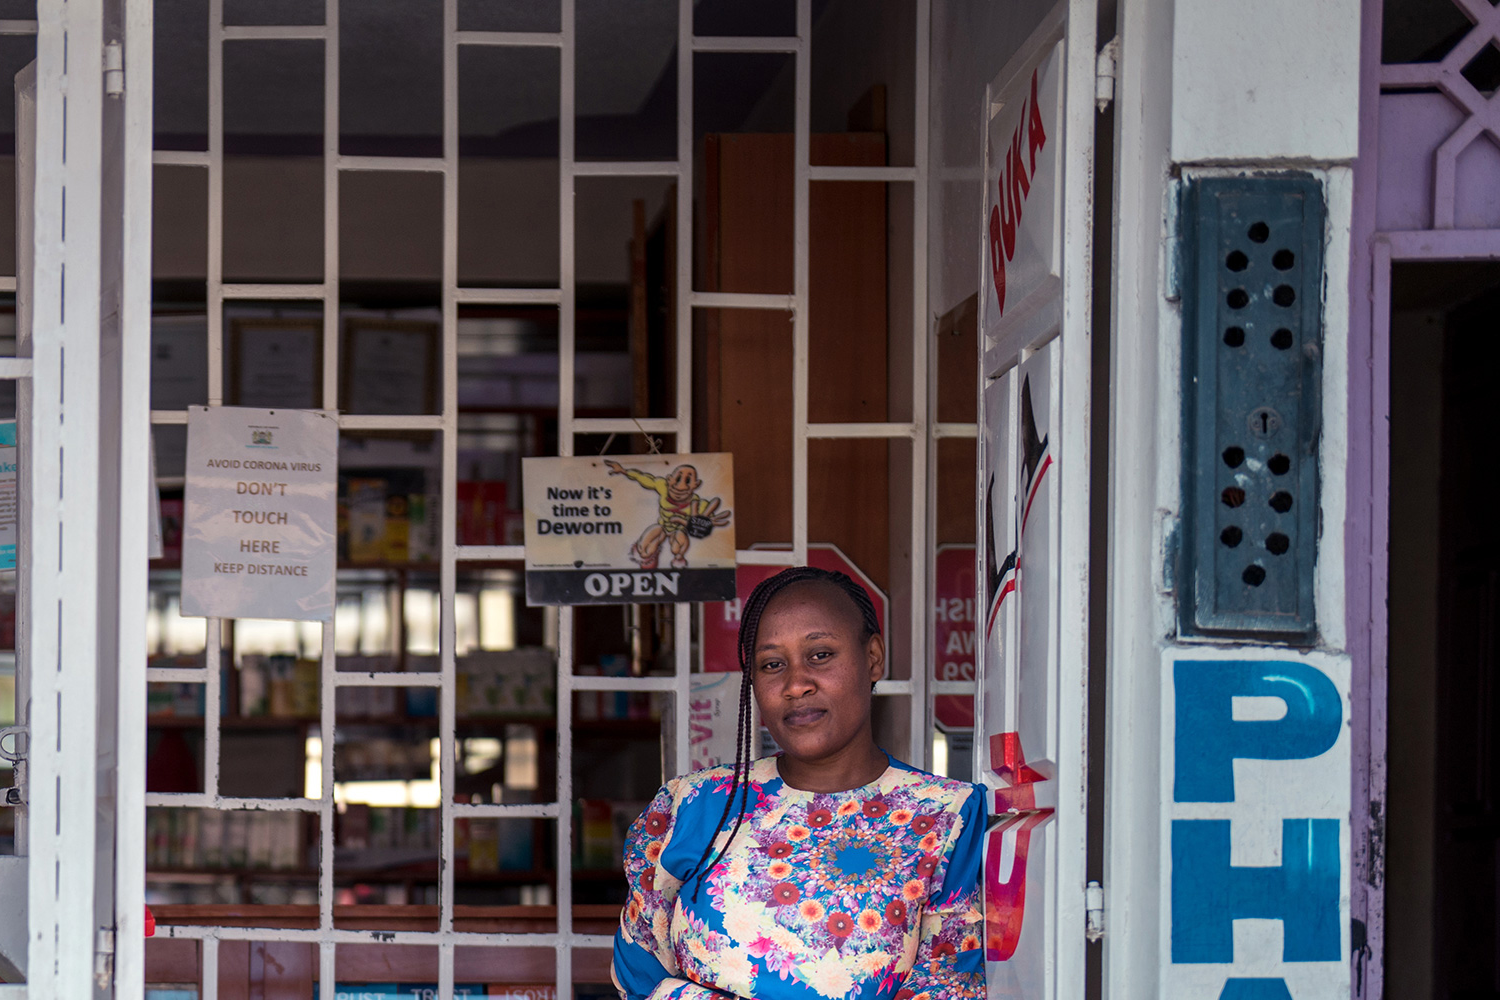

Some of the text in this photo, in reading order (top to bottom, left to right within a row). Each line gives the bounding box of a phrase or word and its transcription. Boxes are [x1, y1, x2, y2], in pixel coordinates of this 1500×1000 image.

[990, 67, 1047, 318] DUKA
[207, 459, 322, 472] AVOID CORONA VIRUS
[547, 487, 612, 500] Now it's
[233, 510, 288, 525] TOUCH
[552, 504, 611, 517] time to
[537, 519, 622, 535] Deworm
[691, 516, 712, 528] STOP
[240, 540, 280, 554] HERE
[214, 563, 308, 577] KEEP DISTANCE
[584, 572, 680, 597] OPEN
